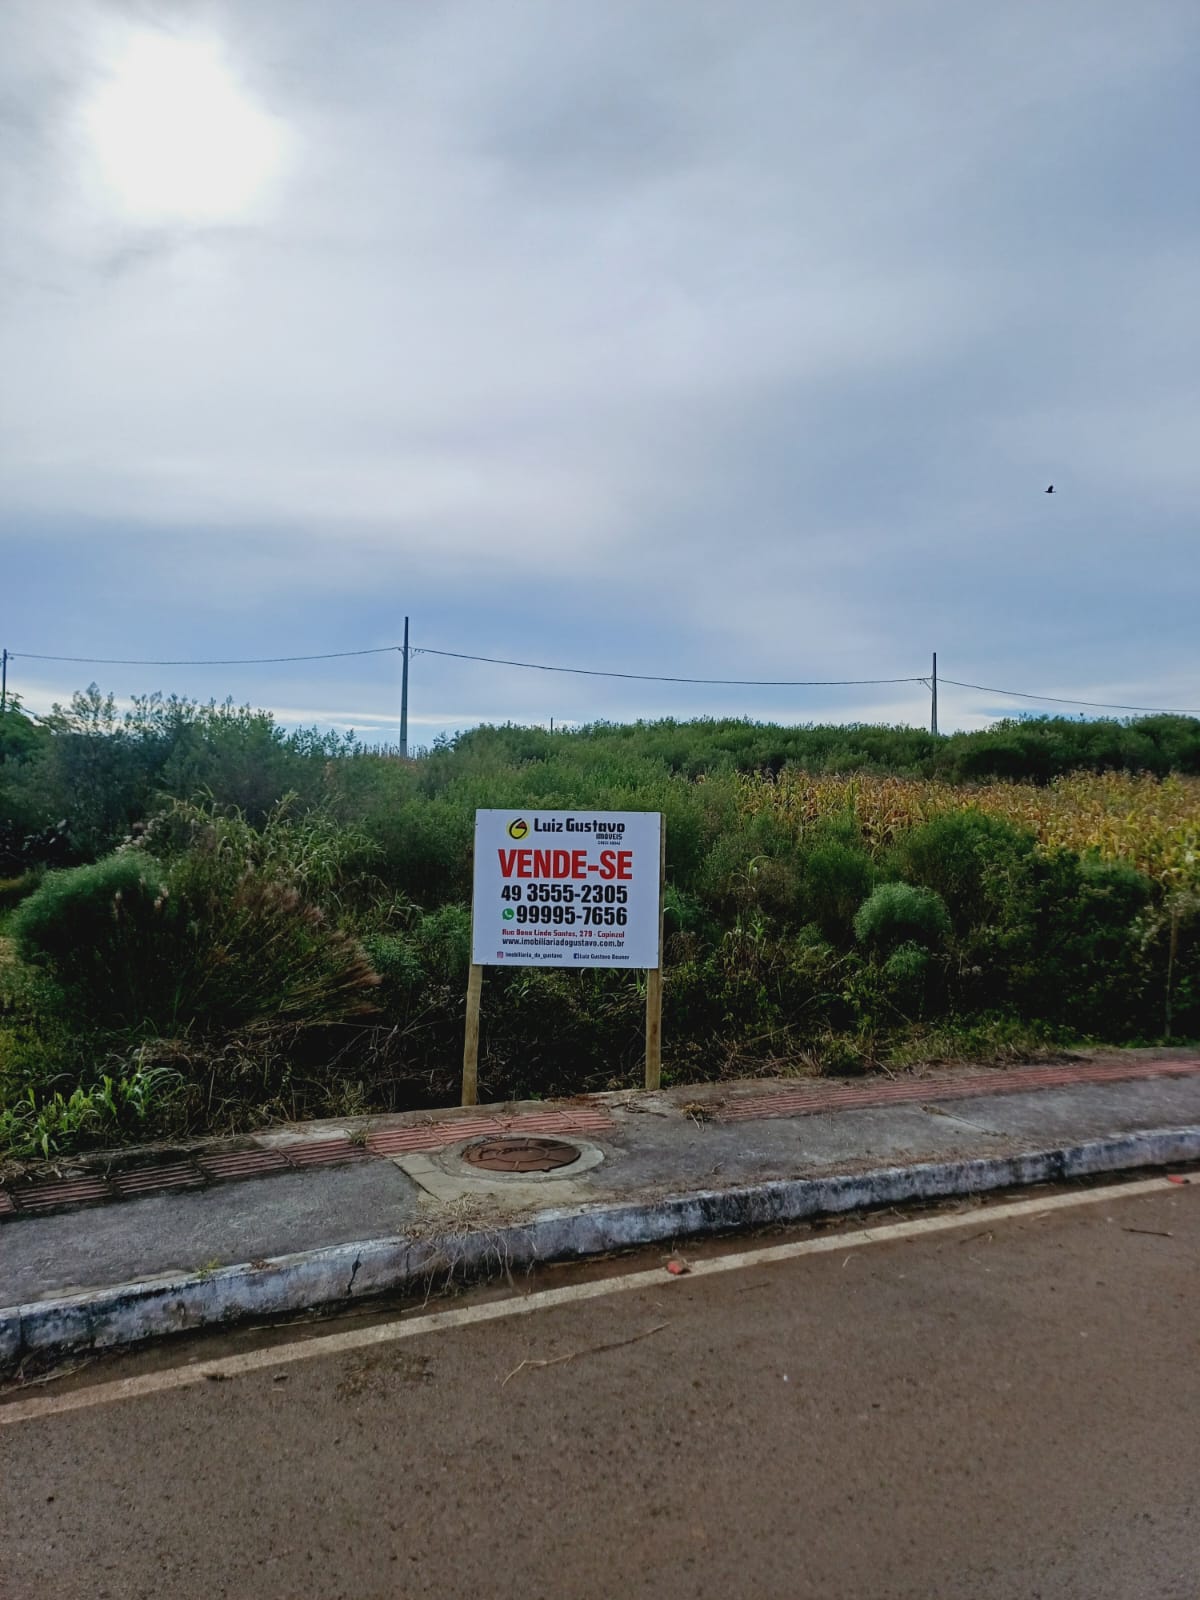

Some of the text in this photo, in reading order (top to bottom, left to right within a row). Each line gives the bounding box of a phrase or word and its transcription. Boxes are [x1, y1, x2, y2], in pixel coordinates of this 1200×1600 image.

[534, 818, 625, 833] Luiz Gustavo
[497, 848, 633, 880] VENDE-SE
[501, 883, 628, 904] 49 3555-2305
[516, 905, 628, 926] 99995-7656
[502, 928, 515, 936] Rua
